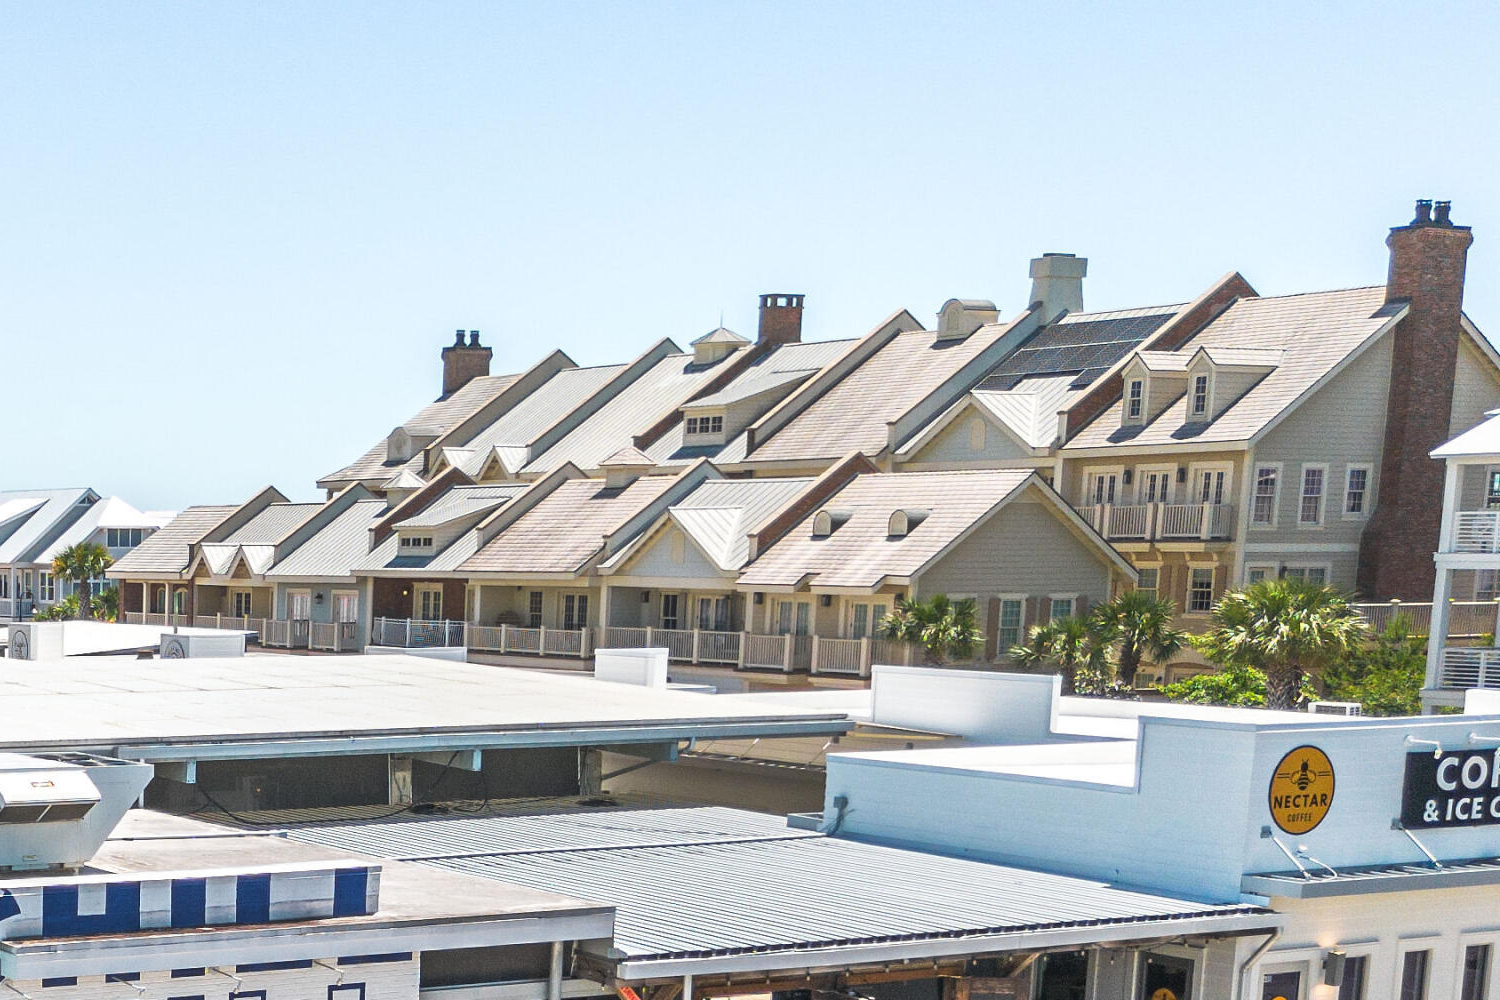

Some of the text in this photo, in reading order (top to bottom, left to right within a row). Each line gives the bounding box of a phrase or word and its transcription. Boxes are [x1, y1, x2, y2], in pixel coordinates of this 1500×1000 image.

[1273, 793, 1329, 811] NECTAR
[1423, 800, 1439, 822] &
[1445, 797, 1484, 821] ICE
[1286, 812, 1313, 823] COFFEE
